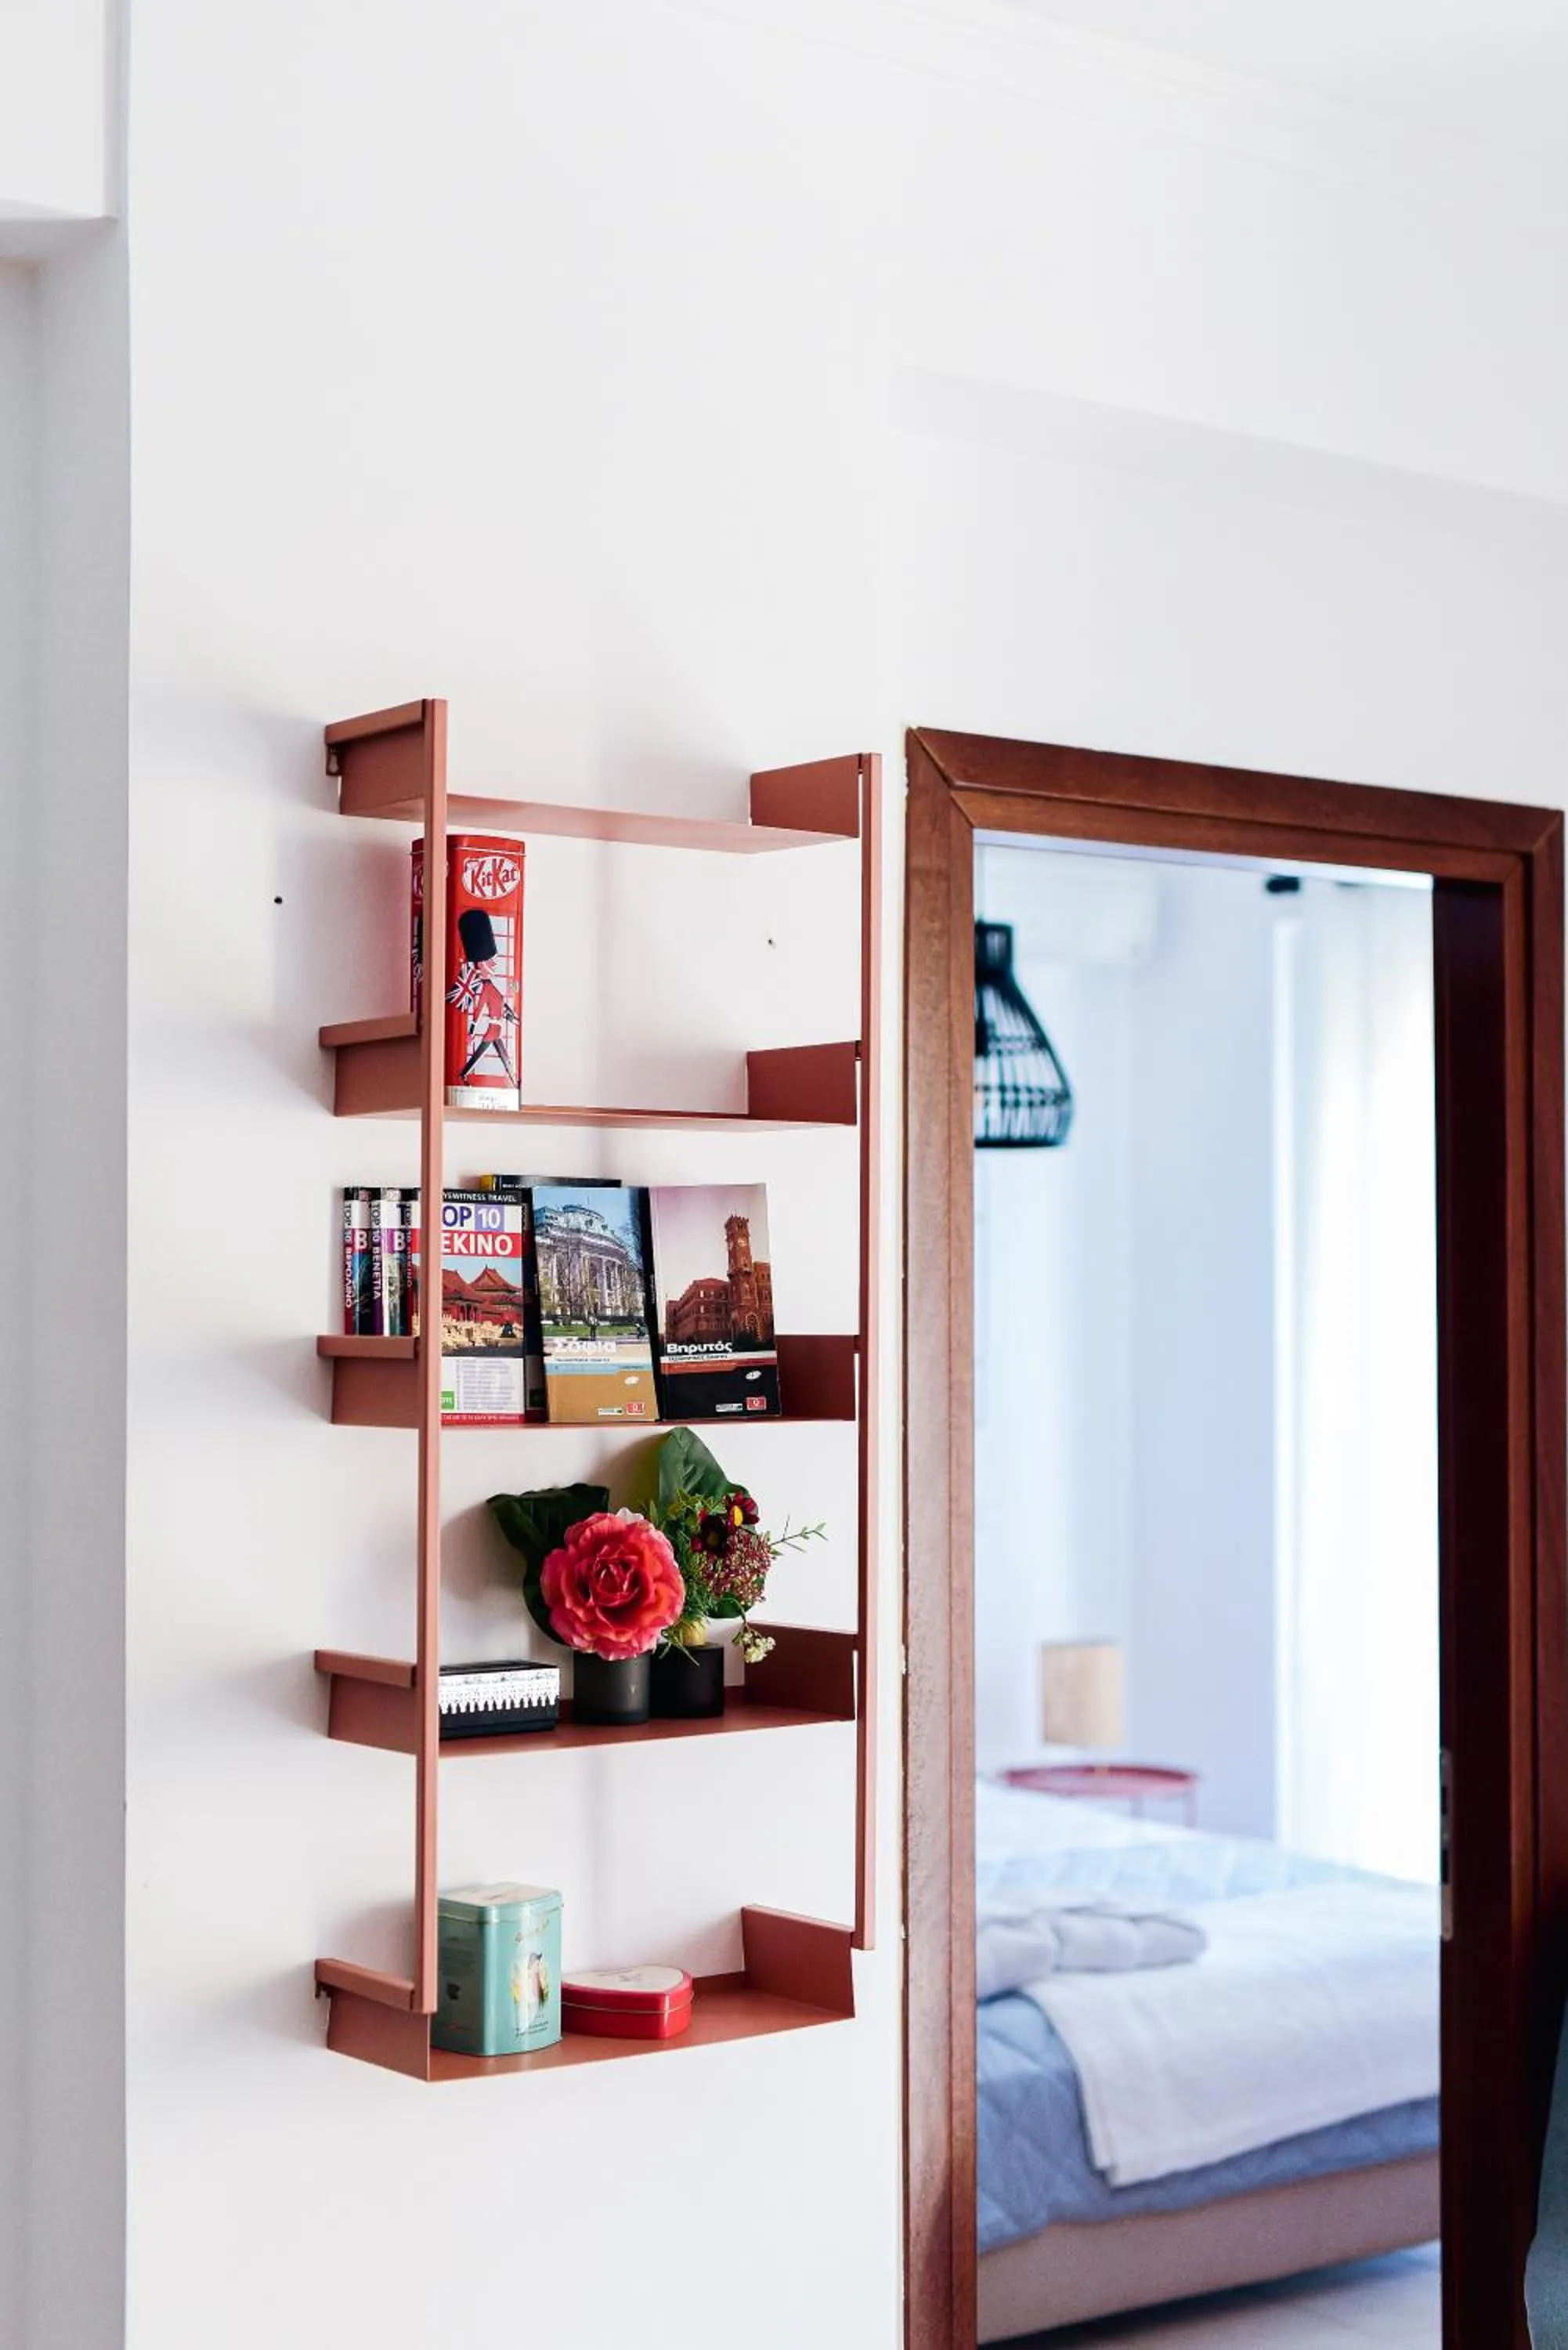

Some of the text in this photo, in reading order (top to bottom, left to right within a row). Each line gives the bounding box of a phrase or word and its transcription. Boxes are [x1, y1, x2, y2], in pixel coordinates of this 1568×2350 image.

[470, 858, 518, 897] KitKat
[443, 1191, 518, 1202] YEWITNESS TRAVEL
[443, 1205, 472, 1227] OP
[478, 1207, 500, 1229] 10
[441, 1231, 514, 1256] ΕΚΙΝΟ
[667, 1340, 733, 1354] Βηρυτός
